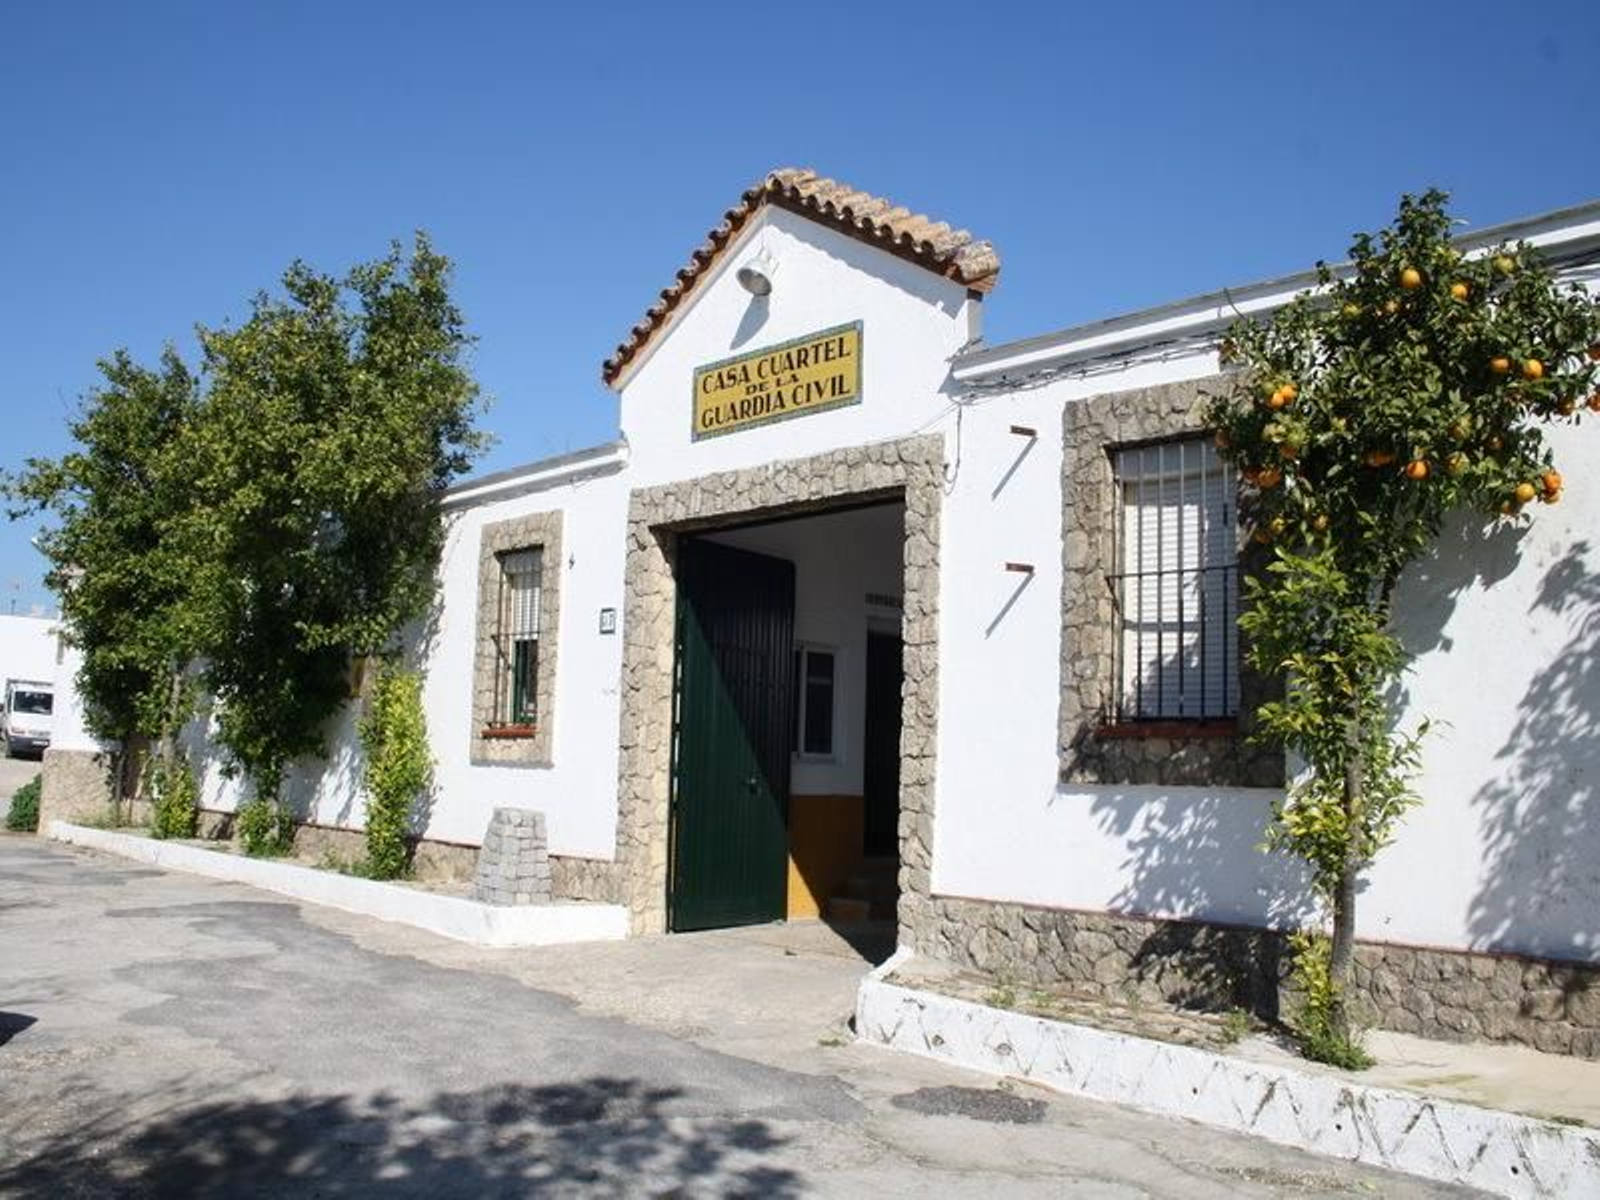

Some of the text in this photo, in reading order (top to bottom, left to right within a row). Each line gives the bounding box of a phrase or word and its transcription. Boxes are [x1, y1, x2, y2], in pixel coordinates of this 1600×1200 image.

[703, 337, 850, 394] CASA CUARTEL
[745, 374, 799, 395] DE LA
[702, 375, 850, 428] GUARDIA CIVIL
